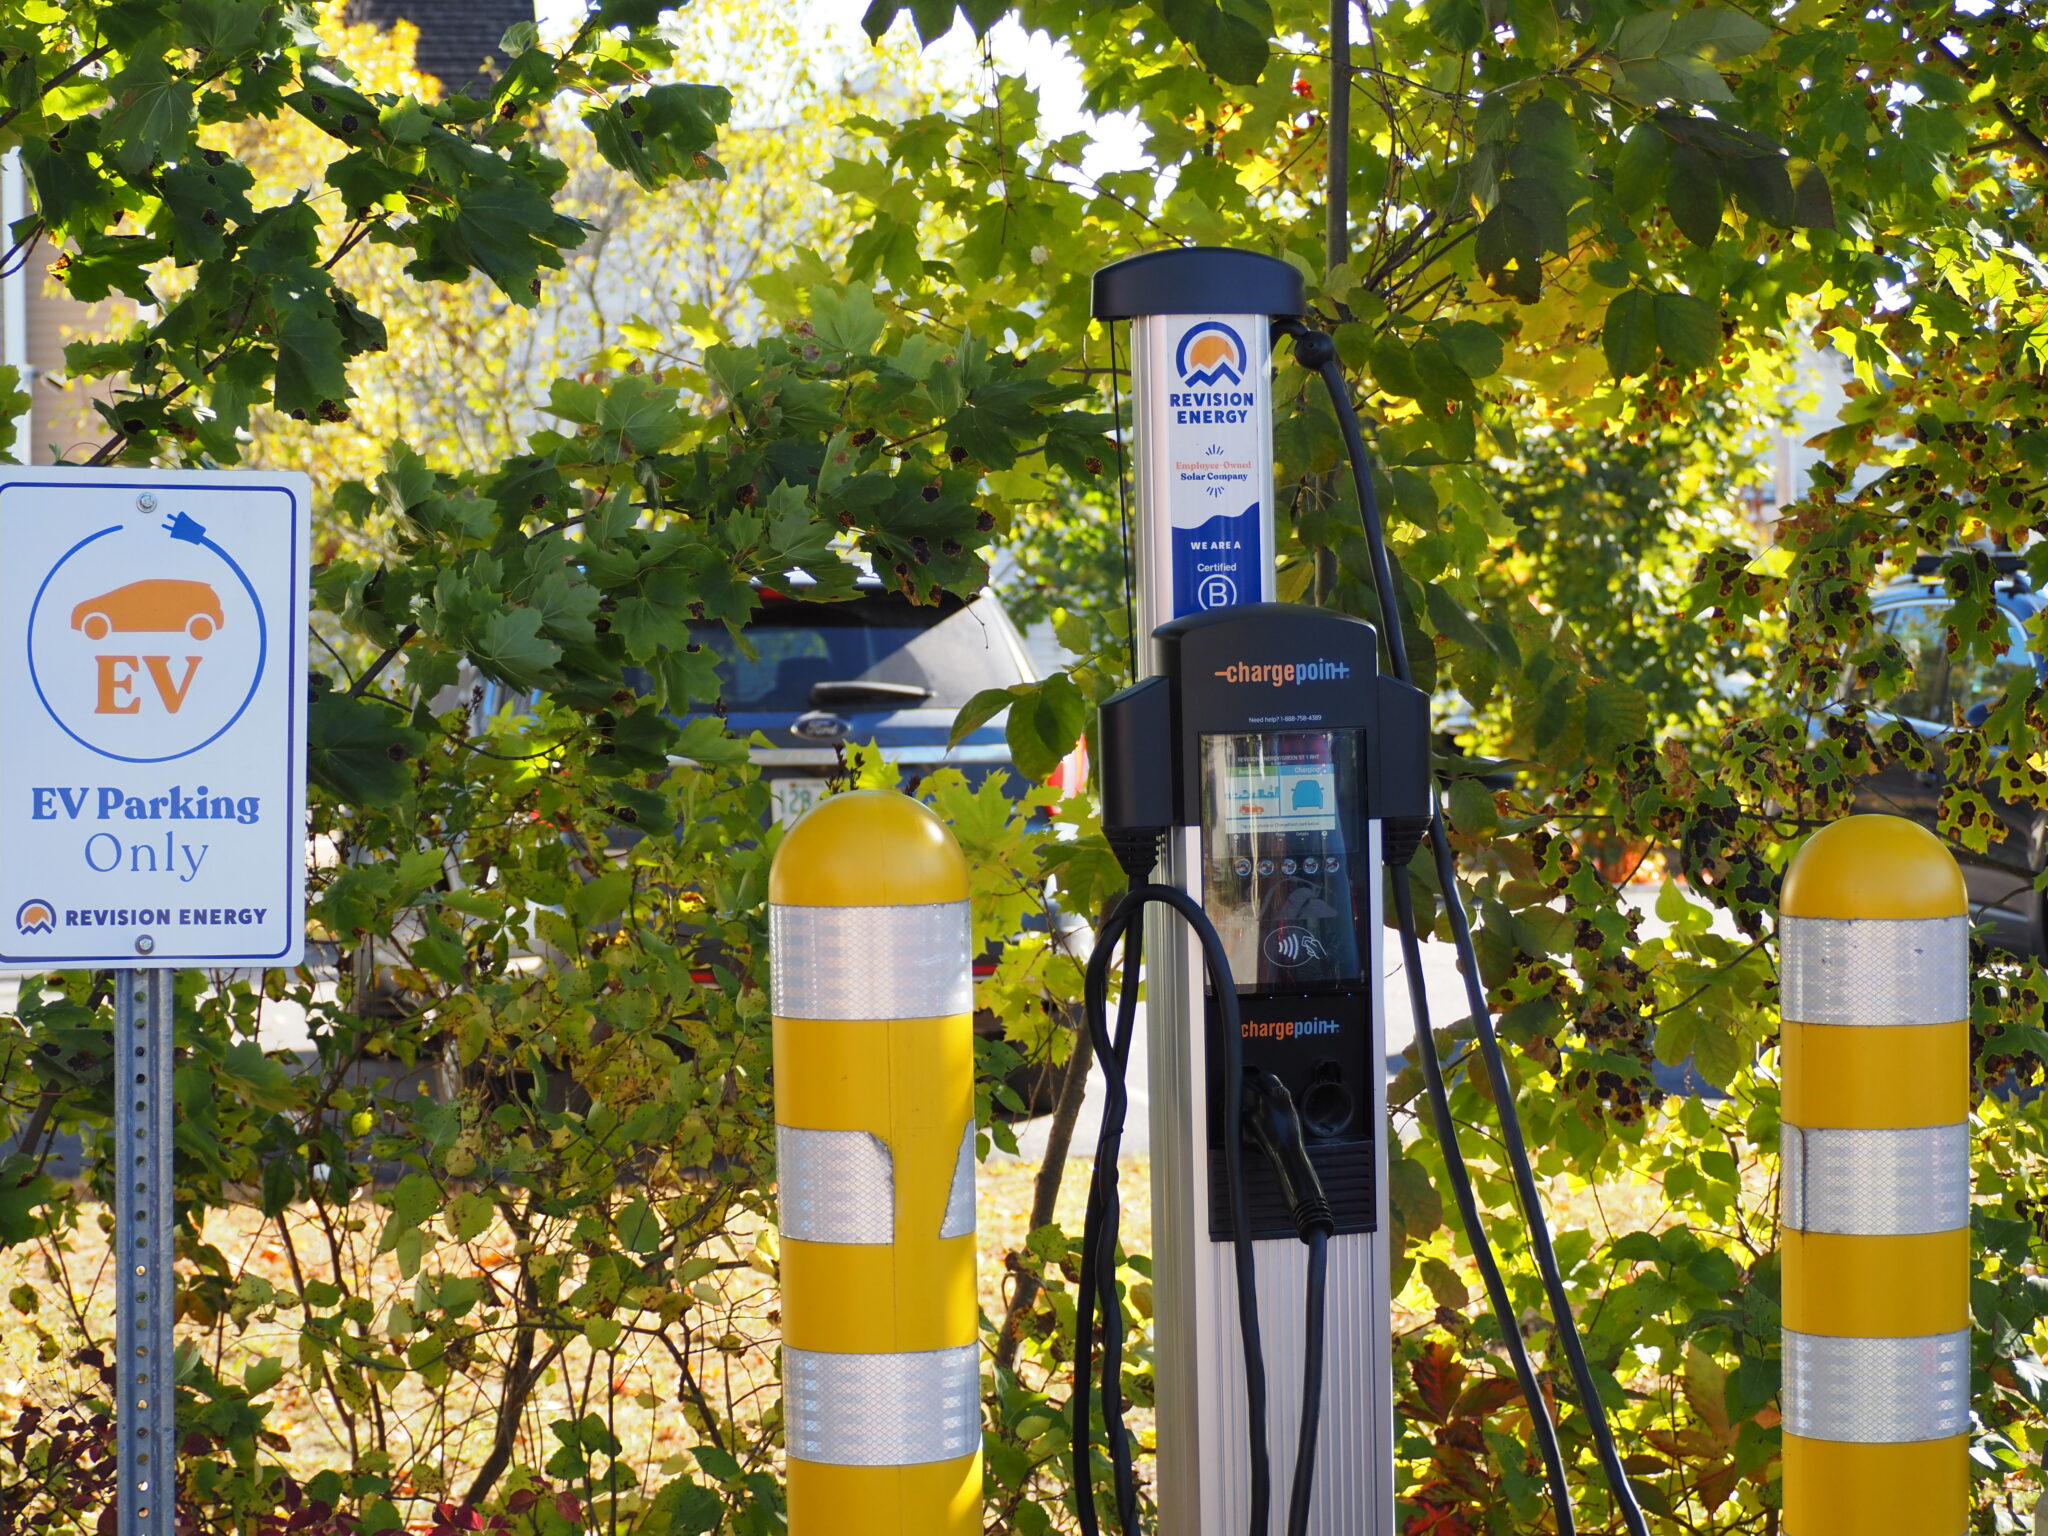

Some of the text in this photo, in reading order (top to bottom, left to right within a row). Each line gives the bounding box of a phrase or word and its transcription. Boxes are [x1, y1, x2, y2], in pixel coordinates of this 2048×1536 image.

[1169, 392, 1255, 407] REVISION
[1176, 410, 1249, 425] ENERGY
[1175, 460, 1252, 471] Employee-Owned
[1180, 472, 1248, 482] Solar Company
[1190, 541, 1241, 550] WE ARE A
[1197, 563, 1237, 572] Certified
[1208, 582, 1228, 607] B
[94, 655, 203, 714] EV
[1248, 716, 1264, 724] Need
[1264, 716, 1280, 724] help?
[31, 785, 261, 824] EV Parking
[84, 831, 209, 883] Only
[65, 908, 268, 926] REVISION ENERGY
